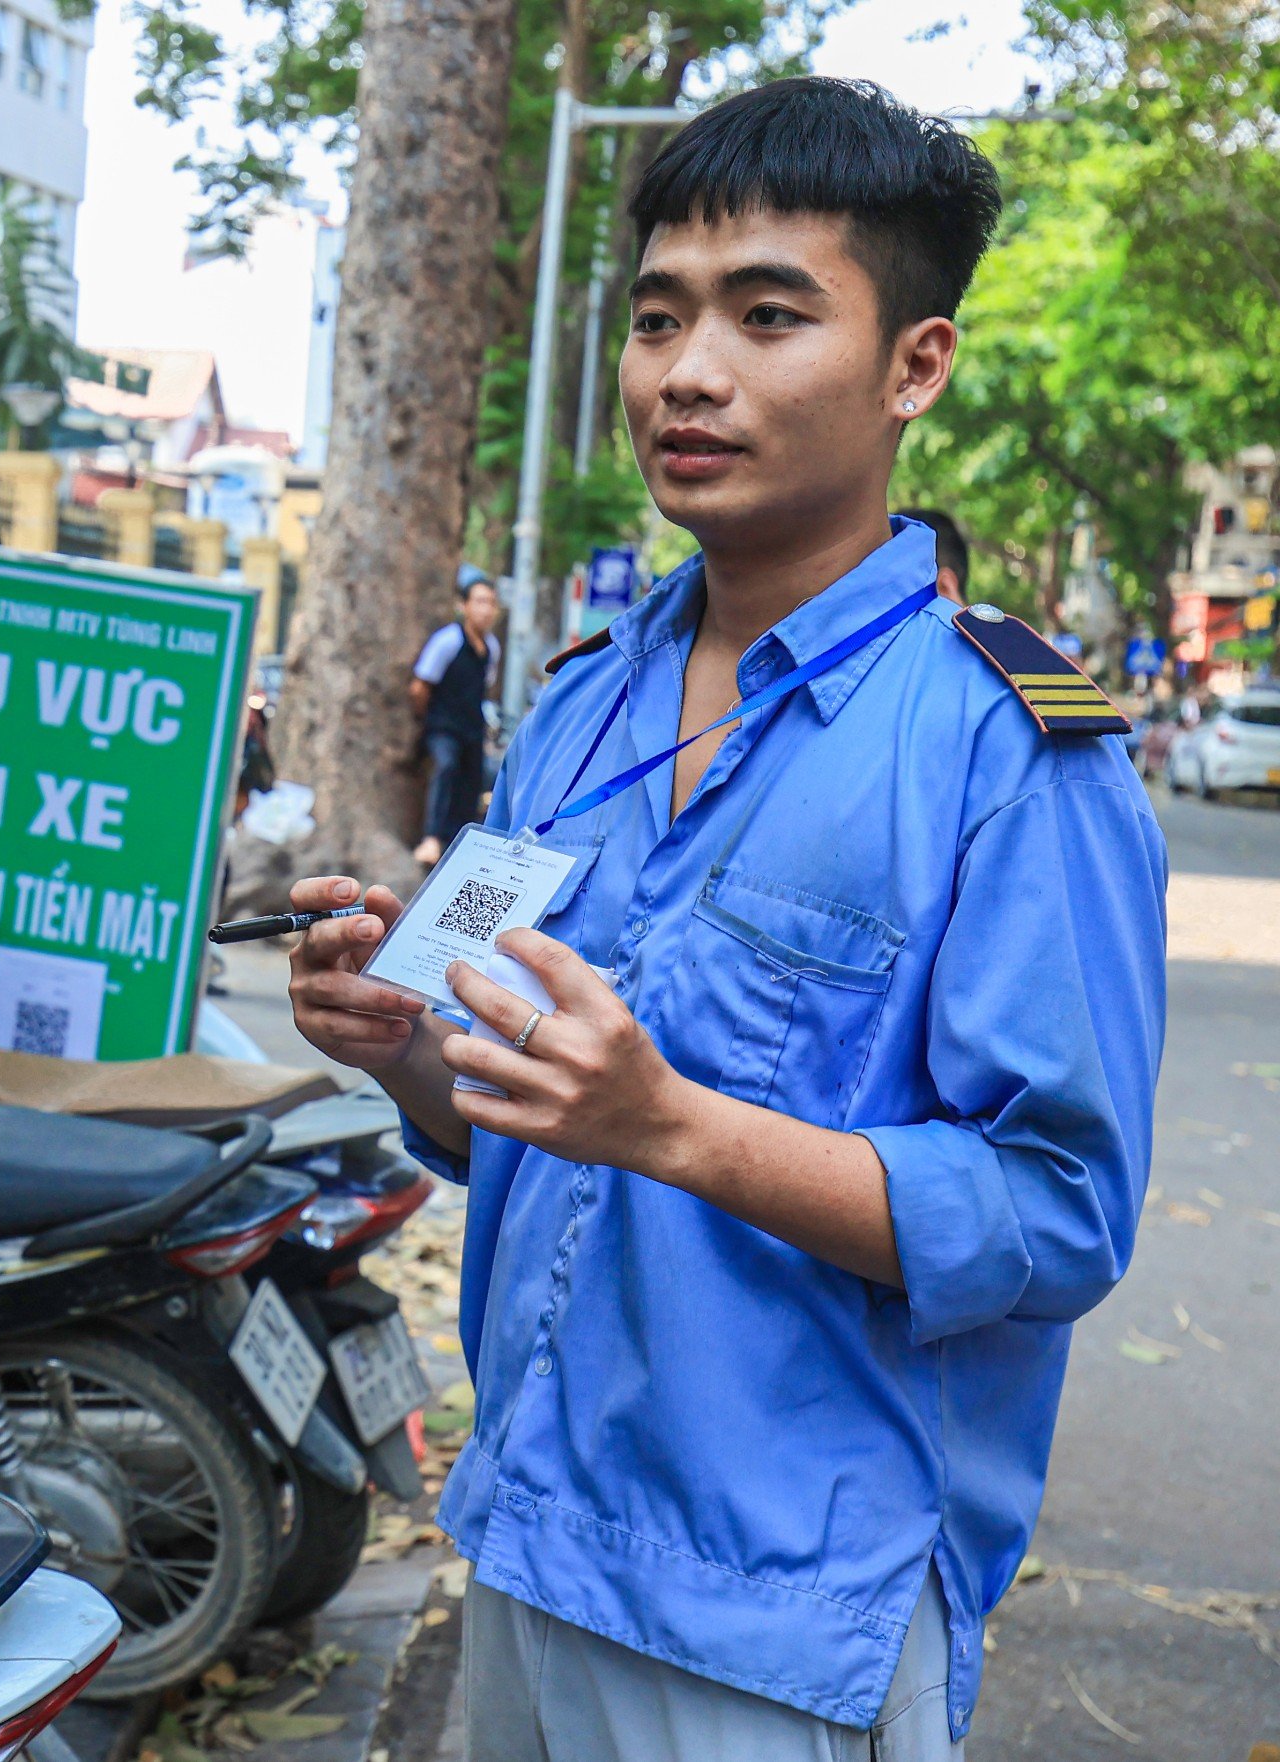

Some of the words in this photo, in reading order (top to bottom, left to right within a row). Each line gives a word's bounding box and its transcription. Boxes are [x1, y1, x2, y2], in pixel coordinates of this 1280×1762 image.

[55, 608, 101, 638] MTV
[166, 624, 217, 656] LINH
[36, 659, 184, 750] VỰC
[28, 773, 128, 850] XE
[97, 883, 180, 972] MẶT
